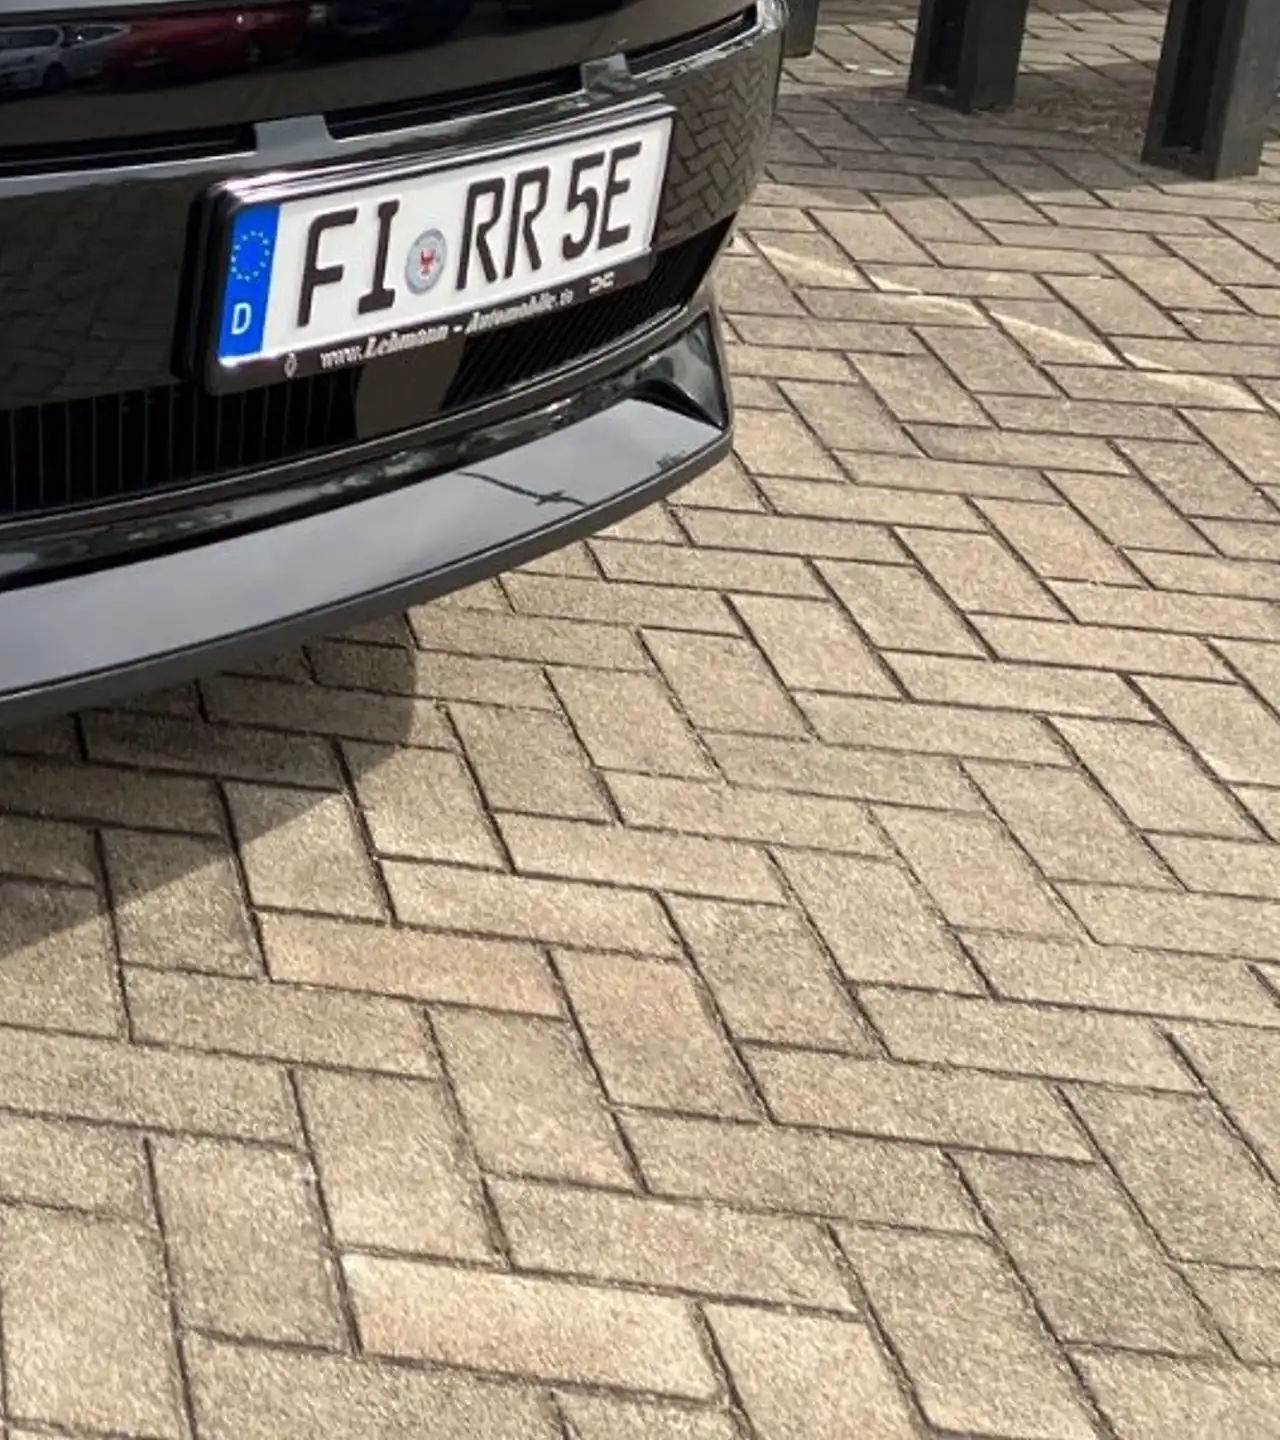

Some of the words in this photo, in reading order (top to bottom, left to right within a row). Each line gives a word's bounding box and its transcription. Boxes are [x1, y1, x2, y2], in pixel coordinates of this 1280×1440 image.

[296, 199, 400, 328] FI
[456, 166, 550, 291] RR
[561, 141, 643, 261] 5E
[229, 302, 252, 337] D
